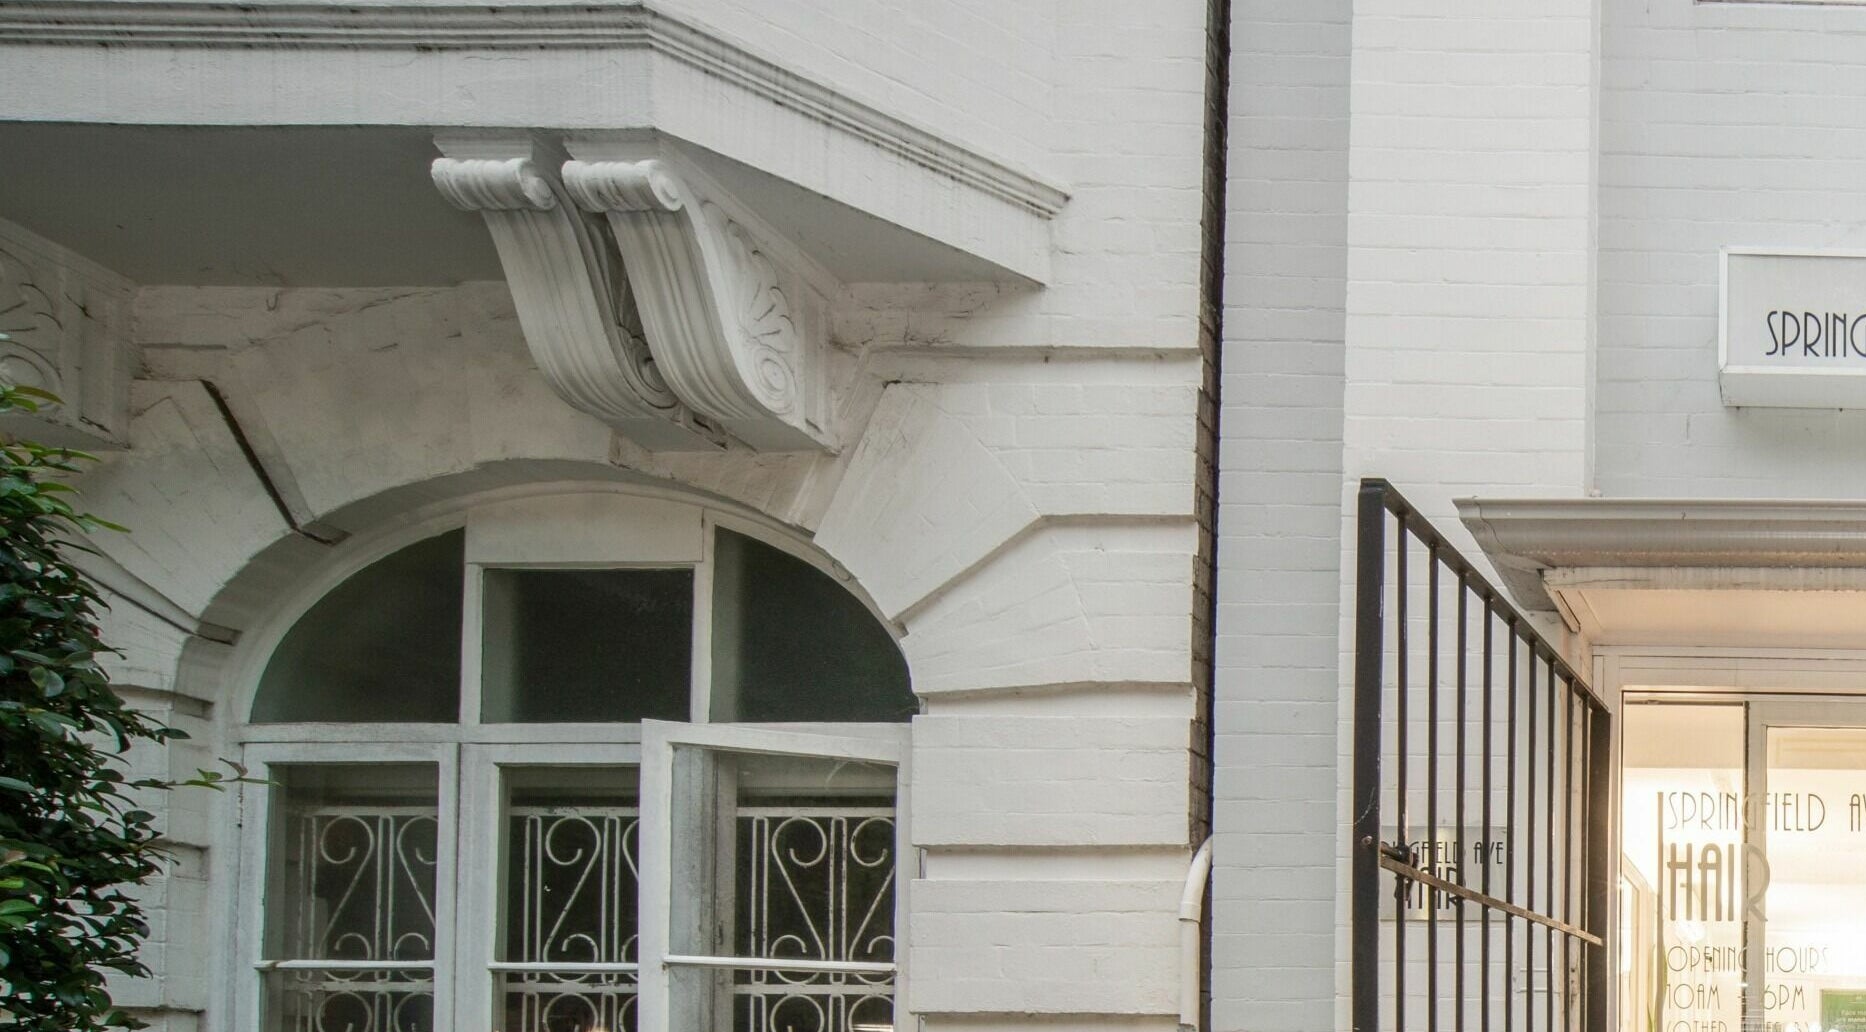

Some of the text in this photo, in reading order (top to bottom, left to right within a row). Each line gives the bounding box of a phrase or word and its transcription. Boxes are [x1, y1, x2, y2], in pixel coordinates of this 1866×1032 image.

[1668, 791, 1826, 832] SPRINGFIELD
[1667, 842, 1770, 922] HAIR
[1666, 983, 1721, 1010] 10AM
[1763, 983, 1806, 1011] 6PM
